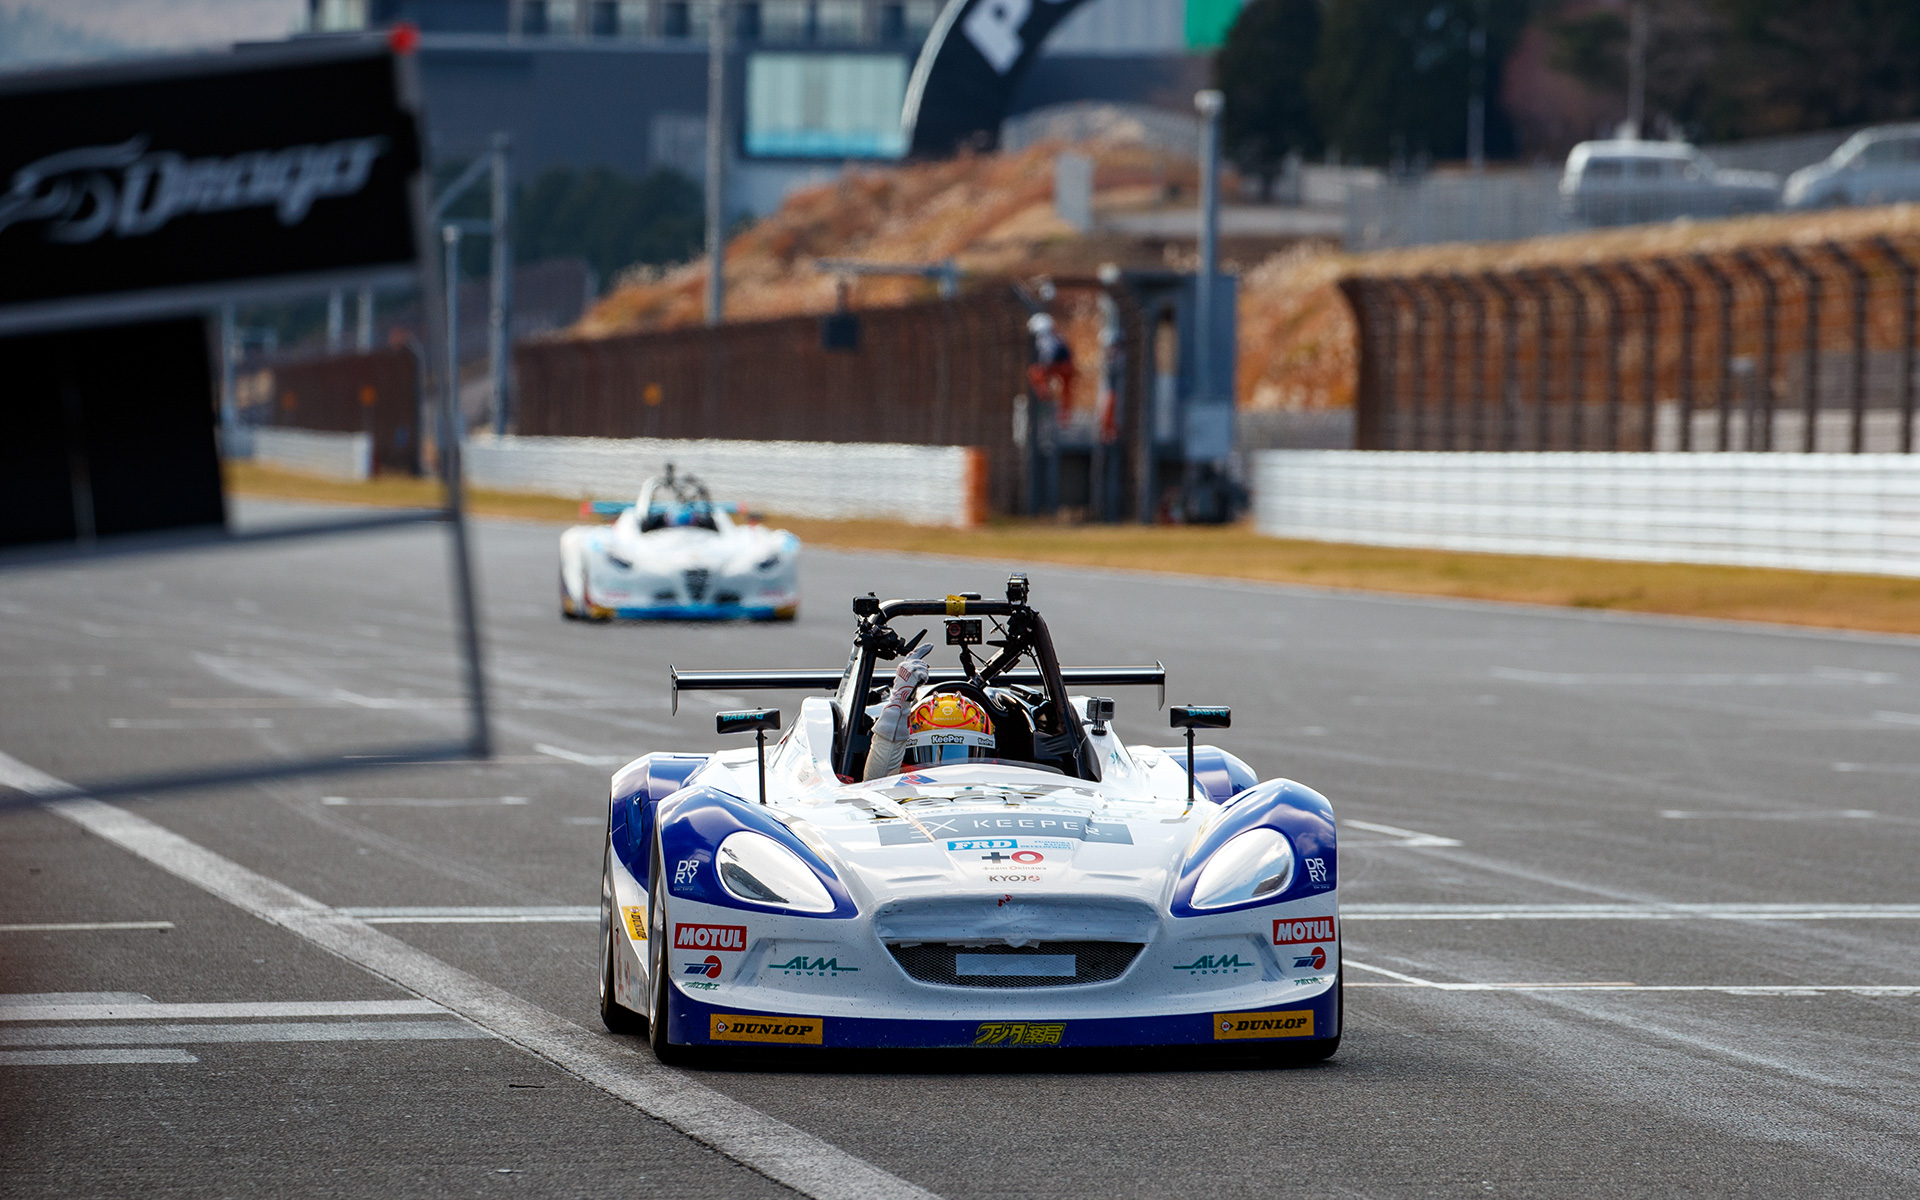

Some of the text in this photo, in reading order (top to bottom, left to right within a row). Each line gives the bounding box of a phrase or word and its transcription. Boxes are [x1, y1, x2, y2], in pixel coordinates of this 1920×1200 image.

[722, 713, 764, 722] BABY-G
[931, 734, 965, 744] KeePer
[973, 819, 1100, 836] KEEPER
[953, 840, 1013, 850] FRD
[677, 927, 743, 948] MOTUL
[1276, 920, 1333, 942] MOTUL
[730, 1023, 814, 1036] DUNLOP
[1235, 1018, 1308, 1031] DUNLOP
[974, 1022, 1066, 1045] フジタ薬局
